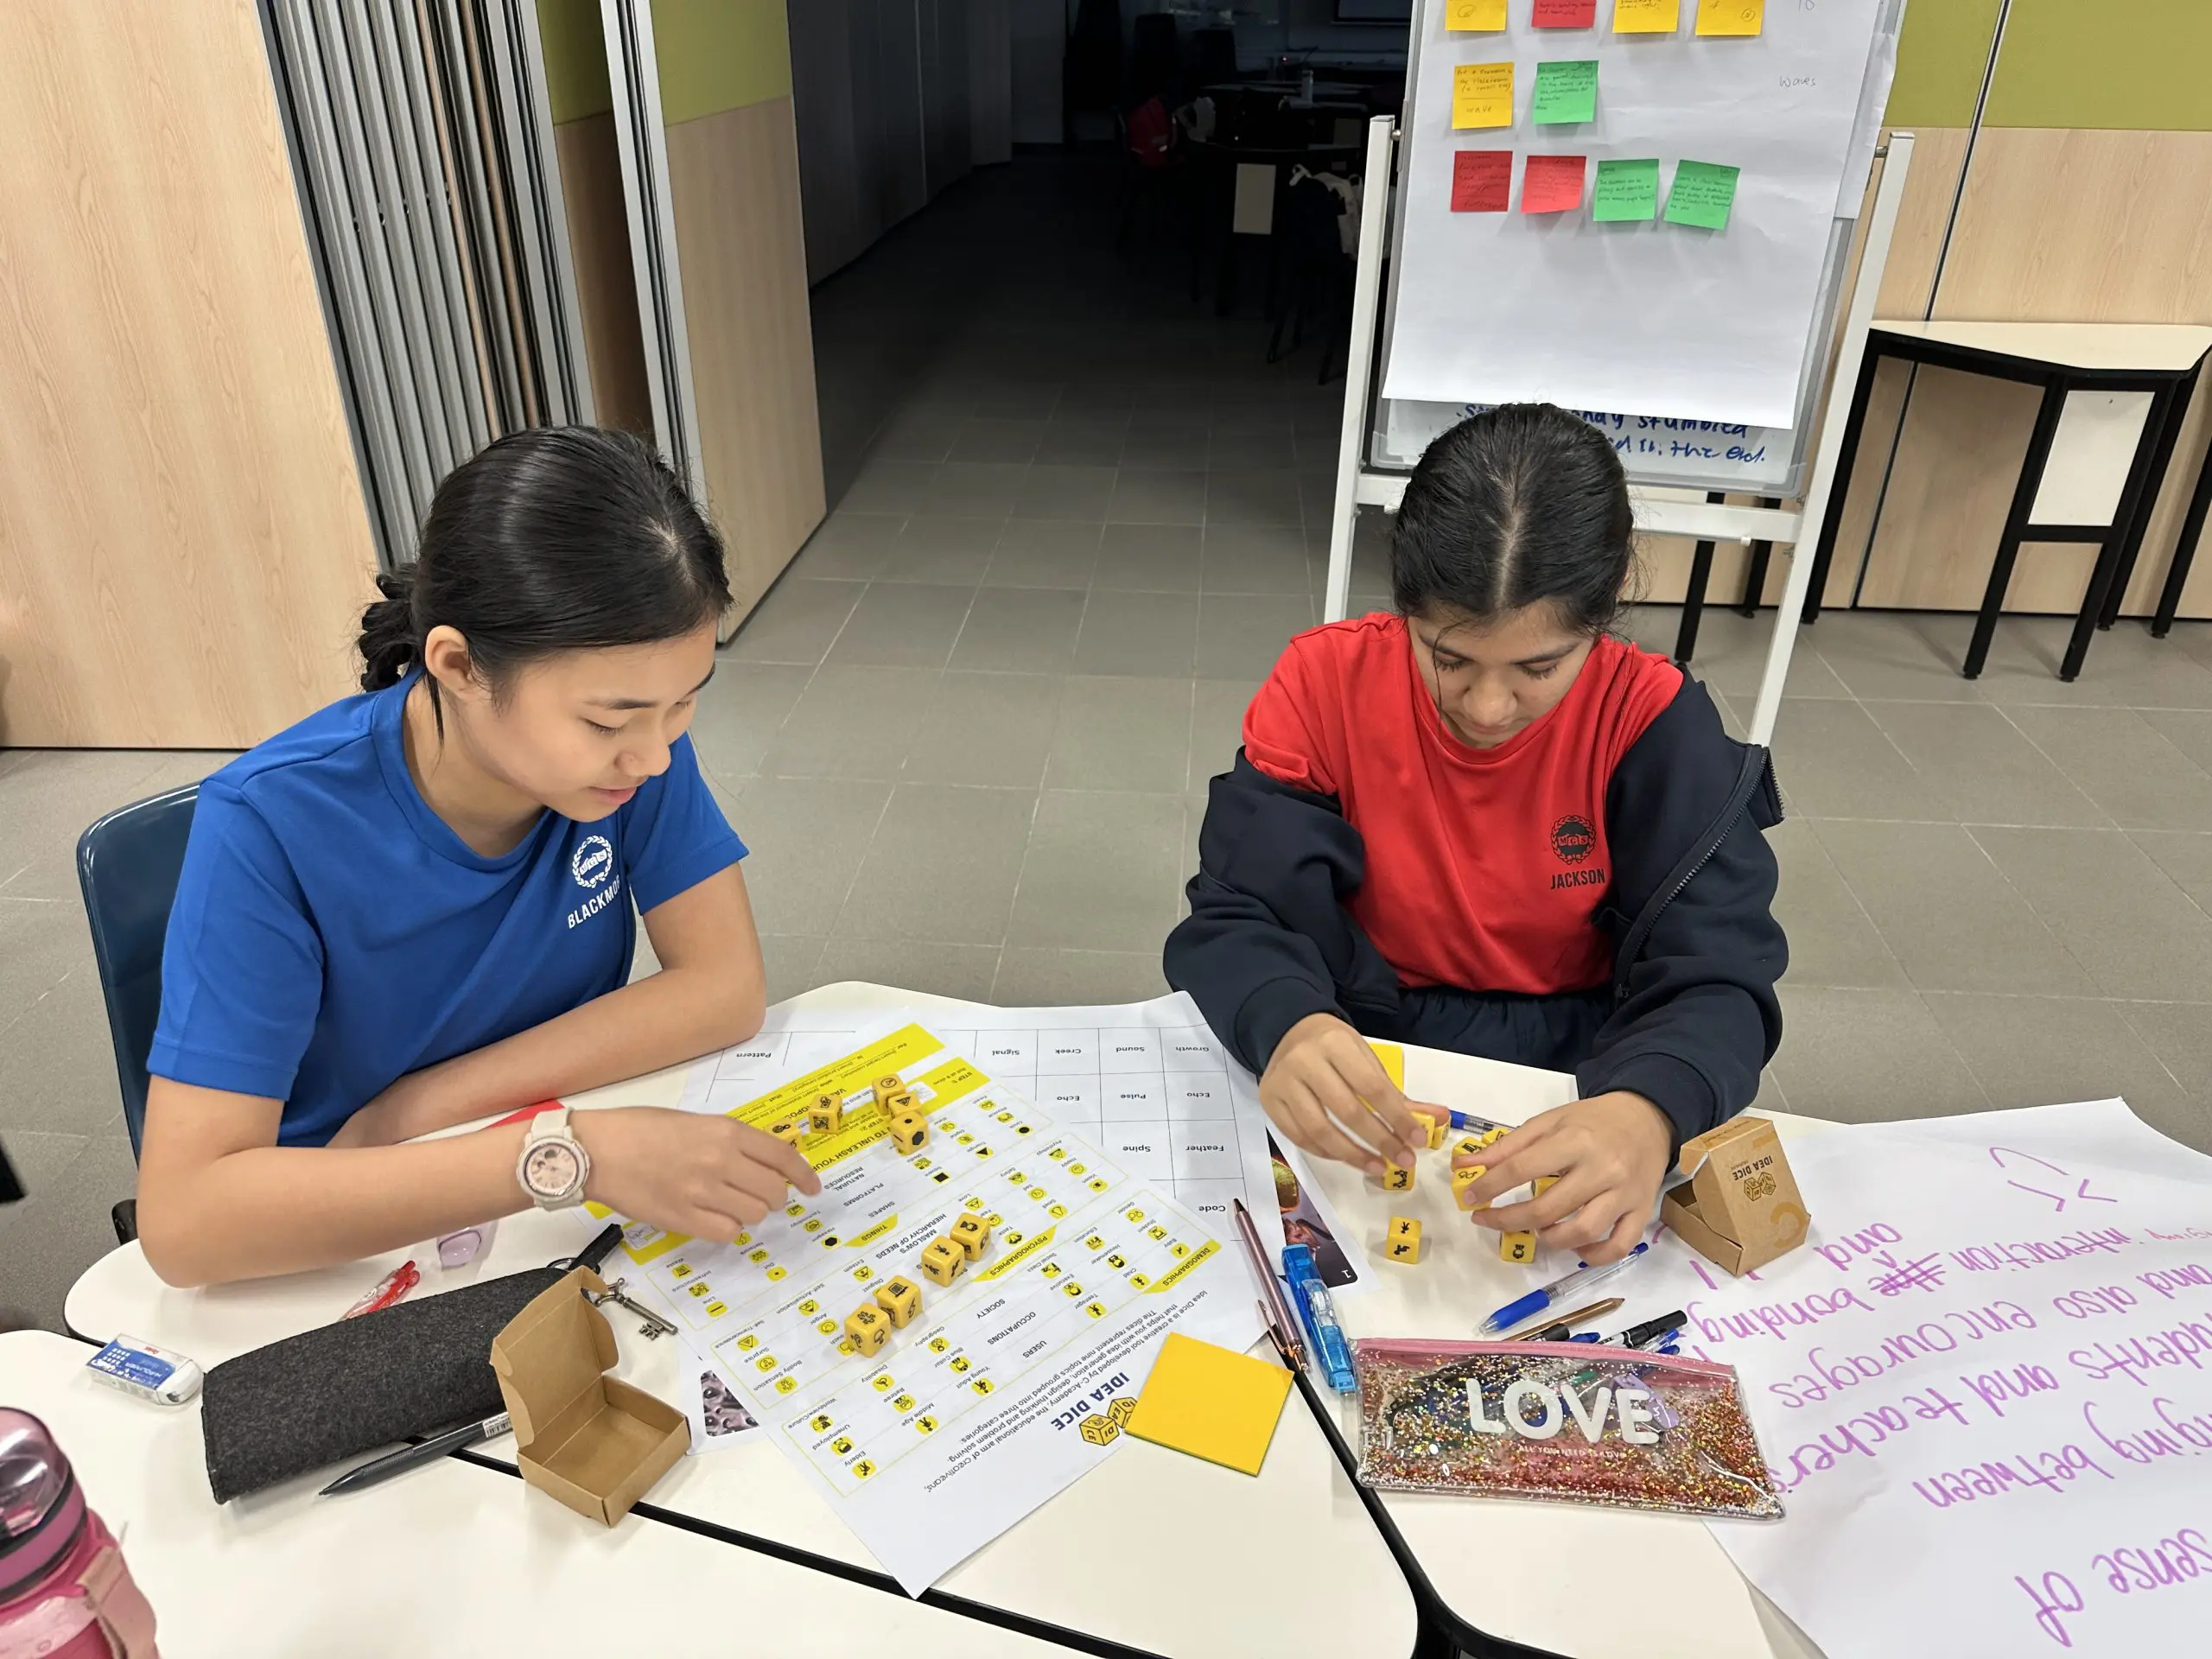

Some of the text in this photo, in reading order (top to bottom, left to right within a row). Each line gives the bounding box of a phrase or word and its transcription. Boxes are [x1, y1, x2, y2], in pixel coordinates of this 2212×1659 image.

[1550, 868, 1606, 890] JACKSON
[736, 1049, 772, 1061] Pattern
[992, 1048, 1021, 1057] Signal
[1175, 1046, 1210, 1054] Growth
[868, 1118, 884, 1128] STEP
[835, 1136, 874, 1159] UNLEASH
[1122, 1144, 1152, 1154] Spine
[1185, 1145, 1225, 1154] Feather
[1751, 1155, 1774, 1170] IDEA
[824, 1167, 863, 1189] RESOURCES
[833, 1173, 864, 1191] NATURAL
[1732, 1166, 1752, 1182] DICE
[843, 1183, 884, 1206] PLATFORMS
[868, 1202, 894, 1217] SHAPES
[1198, 1204, 1227, 1214] Code
[861, 1225, 887, 1241] THINGS
[910, 1214, 946, 1239] HIERARCHY
[1074, 1227, 1097, 1243] Education
[900, 1226, 937, 1253] MASLOW'S
[1164, 1238, 1177, 1248] Baby
[1815, 1221, 1904, 1271] and
[876, 1243, 899, 1258] NEEDS
[990, 1236, 1047, 1275] PSYCHOGRAPHICS
[844, 1259, 864, 1272] Esteem
[1123, 1268, 1136, 1278] Child
[1163, 1248, 1211, 1286] DEMOGRAPHICS
[1342, 1268, 1352, 1281] 1
[862, 1279, 884, 1292] Disgust
[1687, 1225, 2133, 1345] interaction bonding
[2136, 1262, 2212, 1300] and
[1192, 1291, 1207, 1301] Idea
[2051, 1285, 2139, 1320] also
[977, 1300, 1005, 1319] SOCIETY
[1143, 1311, 1156, 1319] The
[1179, 1301, 1194, 1313] Dice
[810, 1313, 827, 1325] Anger
[1126, 1319, 1142, 1331] dices
[915, 1326, 944, 1346] Geography
[988, 1313, 1036, 1344] OCCUPATIONS
[1143, 1322, 1168, 1340] creative
[1023, 1341, 1046, 1357] USERS
[1096, 1330, 1126, 1351] represent
[1131, 1339, 1144, 1350] tool
[745, 1347, 769, 1363] Surprise
[1081, 1350, 1096, 1361] nine
[1098, 1347, 1131, 1373] developed
[753, 1360, 802, 1390] Bodily Sensation
[861, 1362, 887, 1382] Disability
[1060, 1360, 1082, 1376] topics
[948, 1304, 1178, 1462] that helps you with idea generation, design thinking and problem solving.
[957, 1367, 990, 1389] Young Adult
[1033, 1374, 1060, 1396] grouped
[884, 1388, 905, 1402] Retiree
[1045, 1377, 1090, 1406] C-Academy,
[1959, 1363, 2060, 1418] and
[1019, 1395, 1033, 1405] into
[1050, 1372, 1131, 1431] IDEA DICE
[788, 1398, 836, 1428] Worldview/Culture
[902, 1403, 934, 1426] Middle Age
[999, 1405, 1019, 1418] three
[1036, 1407, 1048, 1415] the
[1465, 1377, 1660, 1446] LOVE
[812, 1425, 850, 1450] Unemployed
[995, 1415, 1035, 1443] educational
[981, 1441, 995, 1452] arm
[1770, 1387, 1964, 1494] teachers
[845, 1451, 866, 1466] Elderly
[1912, 1444, 2115, 1510] between
[2014, 1566, 2085, 1649] of
